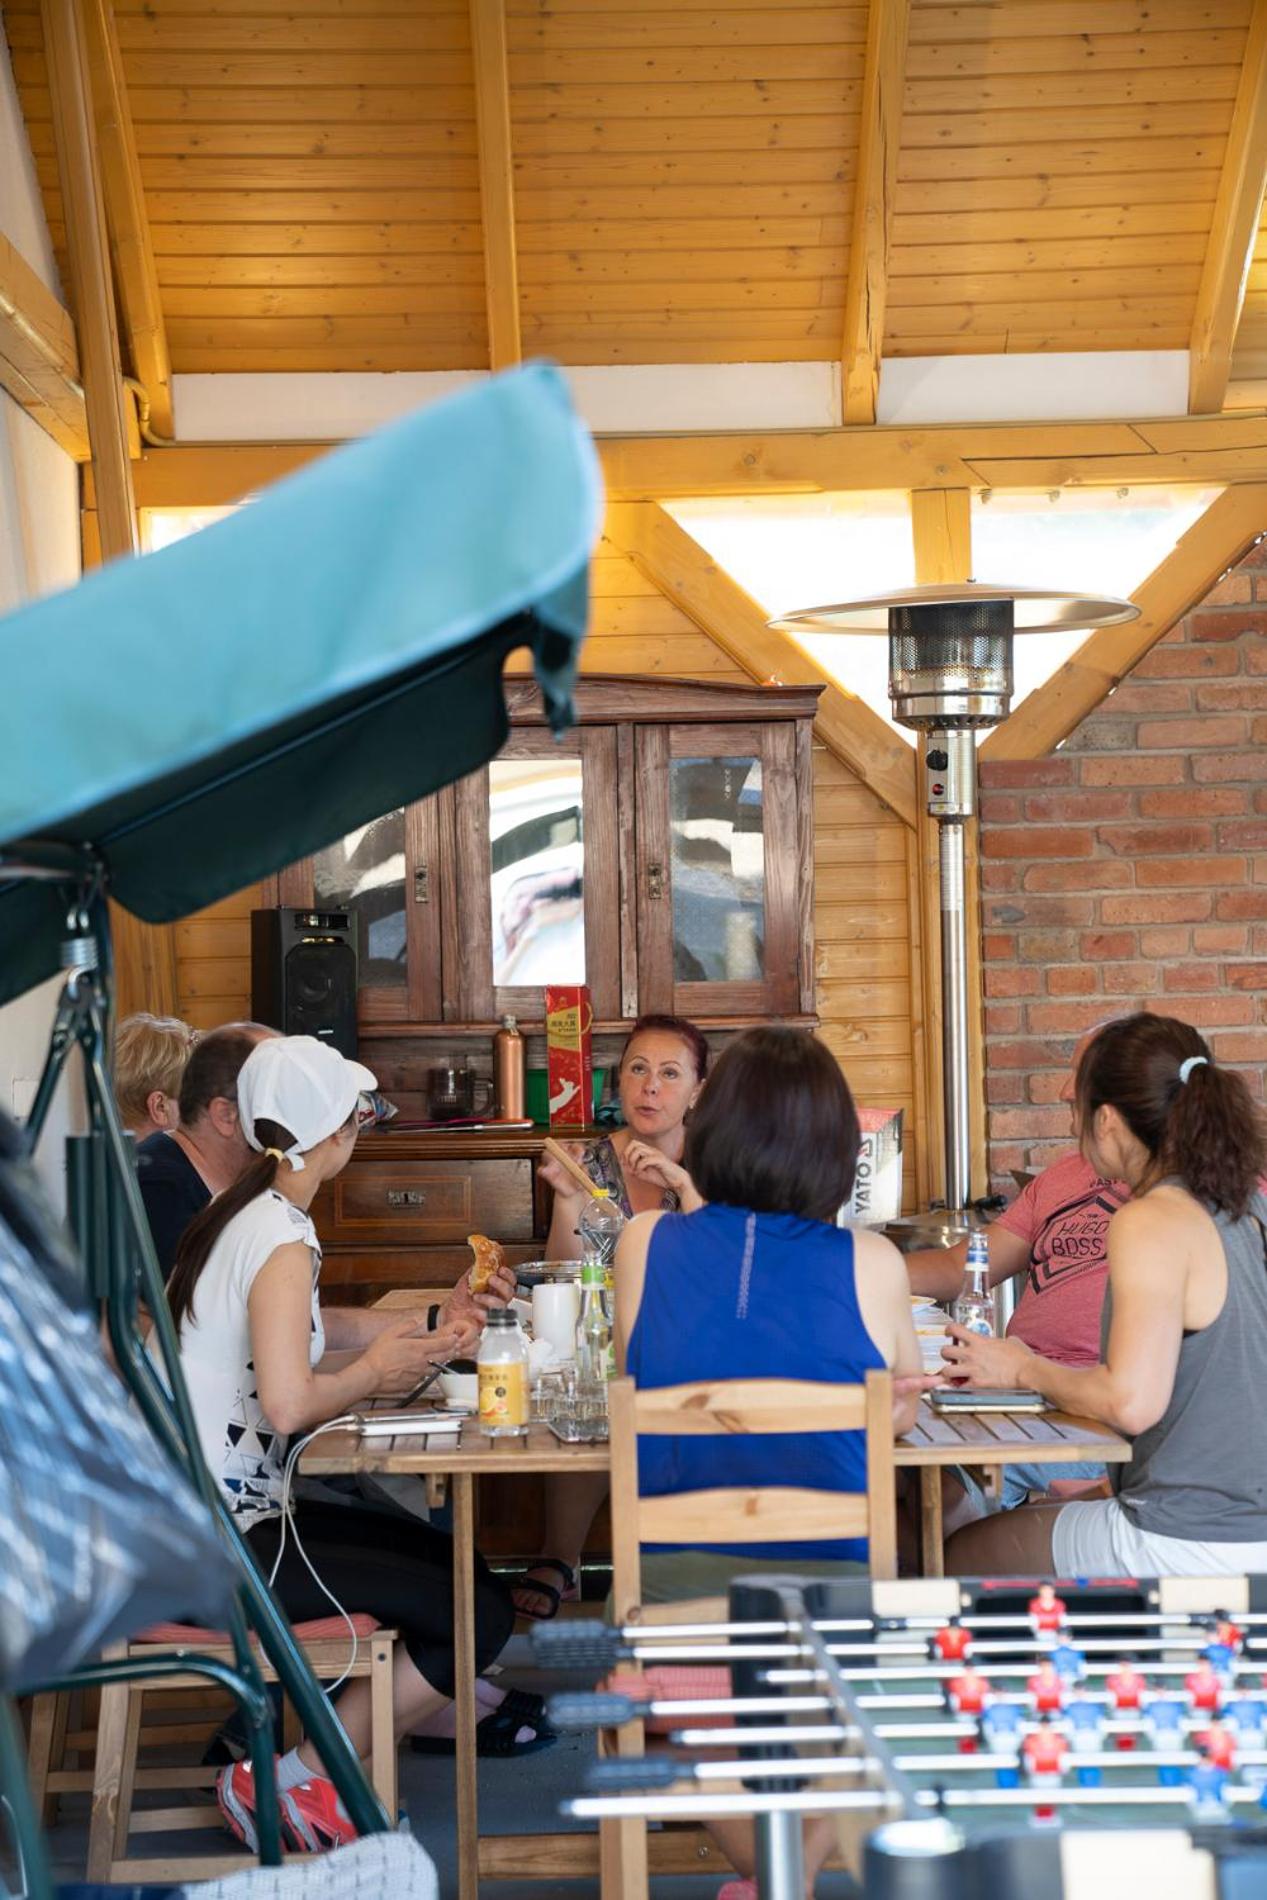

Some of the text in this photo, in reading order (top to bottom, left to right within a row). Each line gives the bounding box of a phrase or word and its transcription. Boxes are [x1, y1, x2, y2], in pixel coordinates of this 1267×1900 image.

[855, 1162, 872, 1214] YATO
[1056, 1220, 1110, 1237] HUGO
[1052, 1237, 1103, 1256] BOSS
